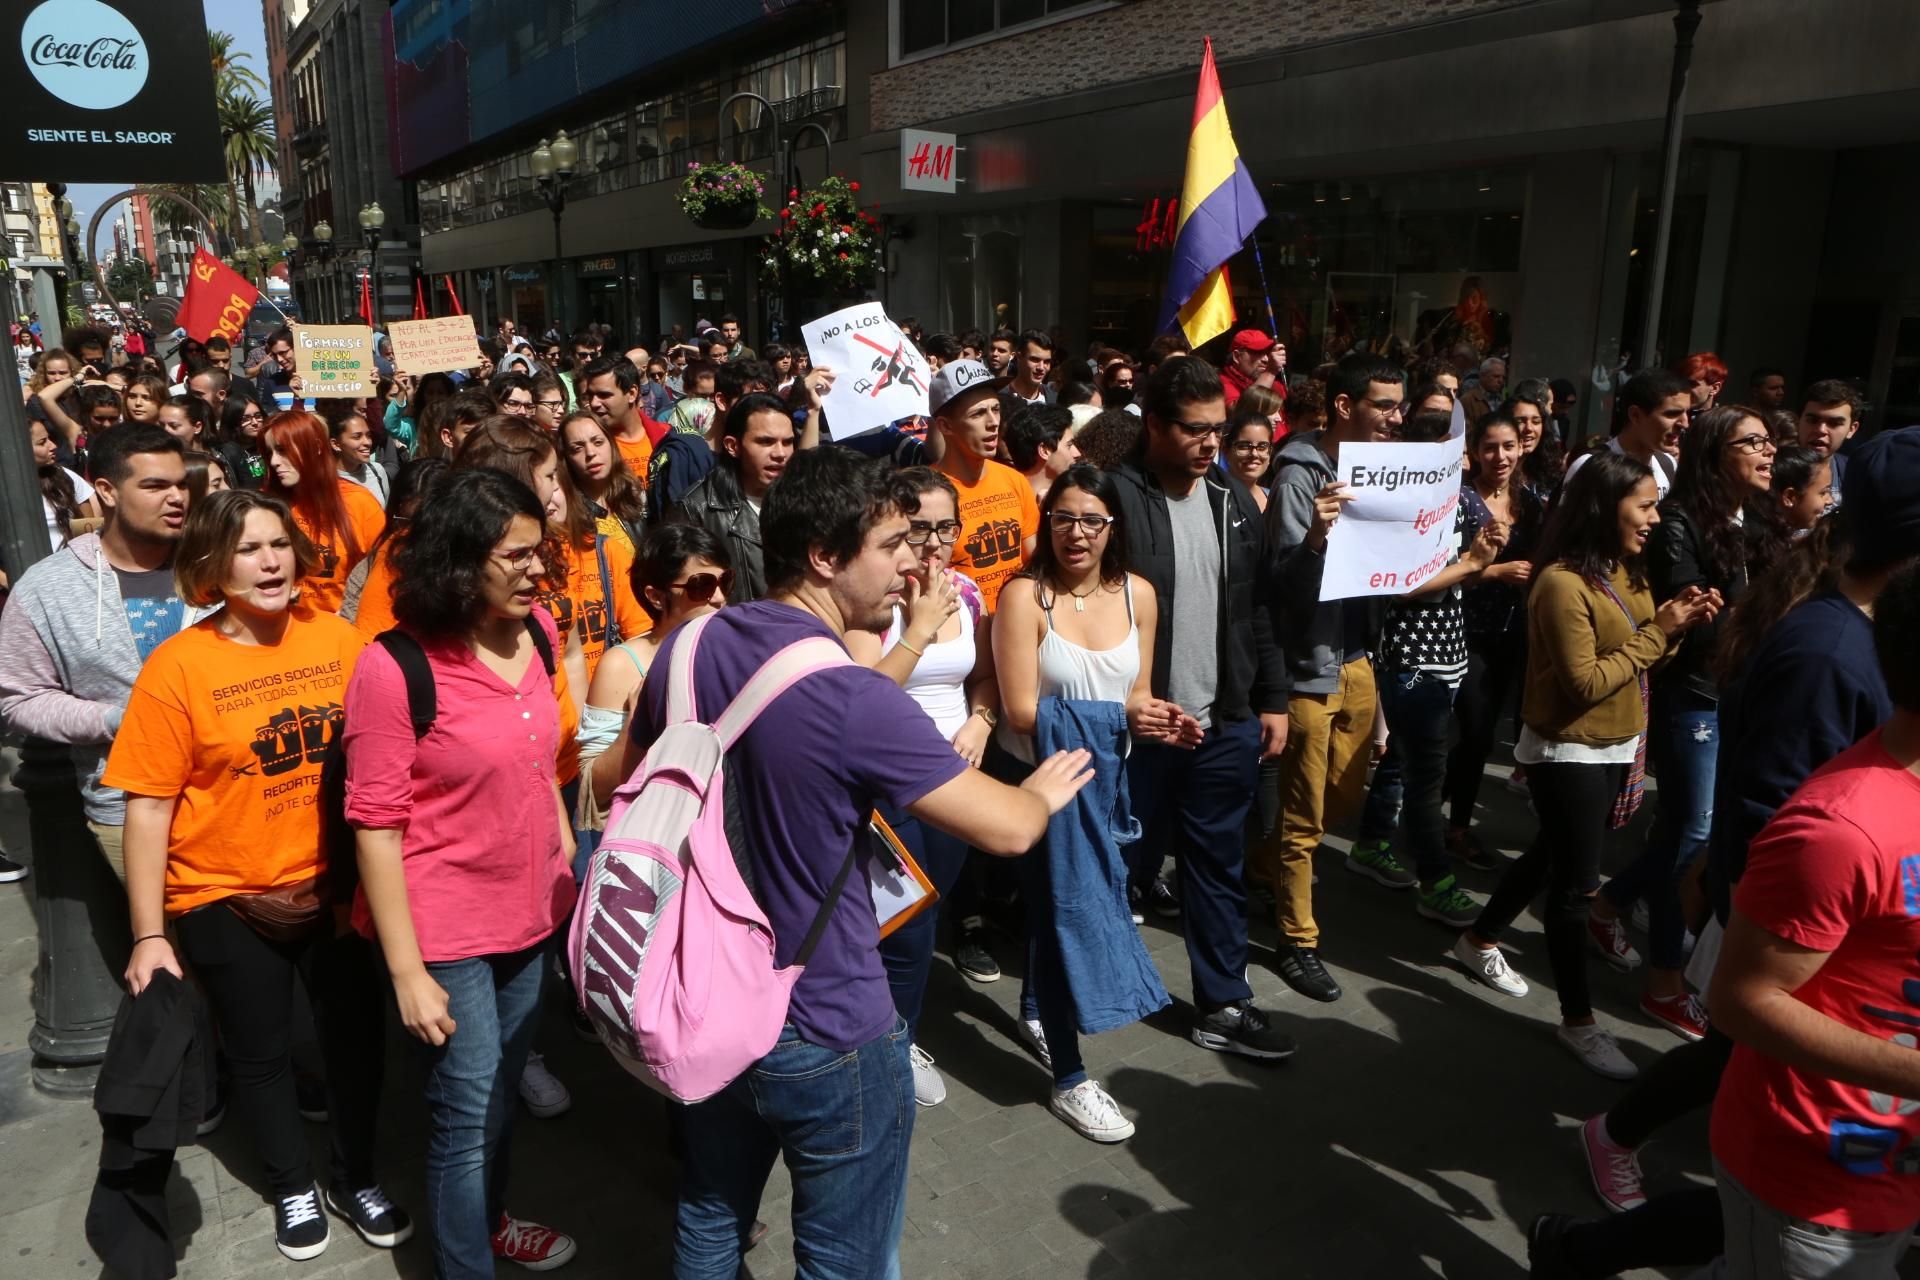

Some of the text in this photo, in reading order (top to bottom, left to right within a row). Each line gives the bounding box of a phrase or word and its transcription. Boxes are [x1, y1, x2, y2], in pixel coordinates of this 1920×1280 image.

[30, 34, 139, 70] Coca-Cola
[28, 129, 88, 142] SIENTE
[91, 131, 112, 143] EL
[909, 142, 954, 182] H&M
[398, 325, 414, 337] NO
[418, 322, 432, 335] AL
[844, 322, 854, 332] A
[855, 315, 880, 329] LOS
[299, 331, 363, 349] FORMARSE
[399, 338, 417, 350] POR
[312, 349, 352, 361] ES UN
[311, 360, 361, 371] DERECHO
[320, 371, 336, 380] NO
[1350, 465, 1445, 492] Exigimos
[1369, 572, 1397, 588] en
[212, 673, 282, 702] SERVICIOS
[215, 696, 256, 717] PARA
[255, 683, 299, 702] TODAS
[299, 681, 309, 693] Y
[263, 774, 322, 801] RECORTE
[285, 799, 300, 812] TE
